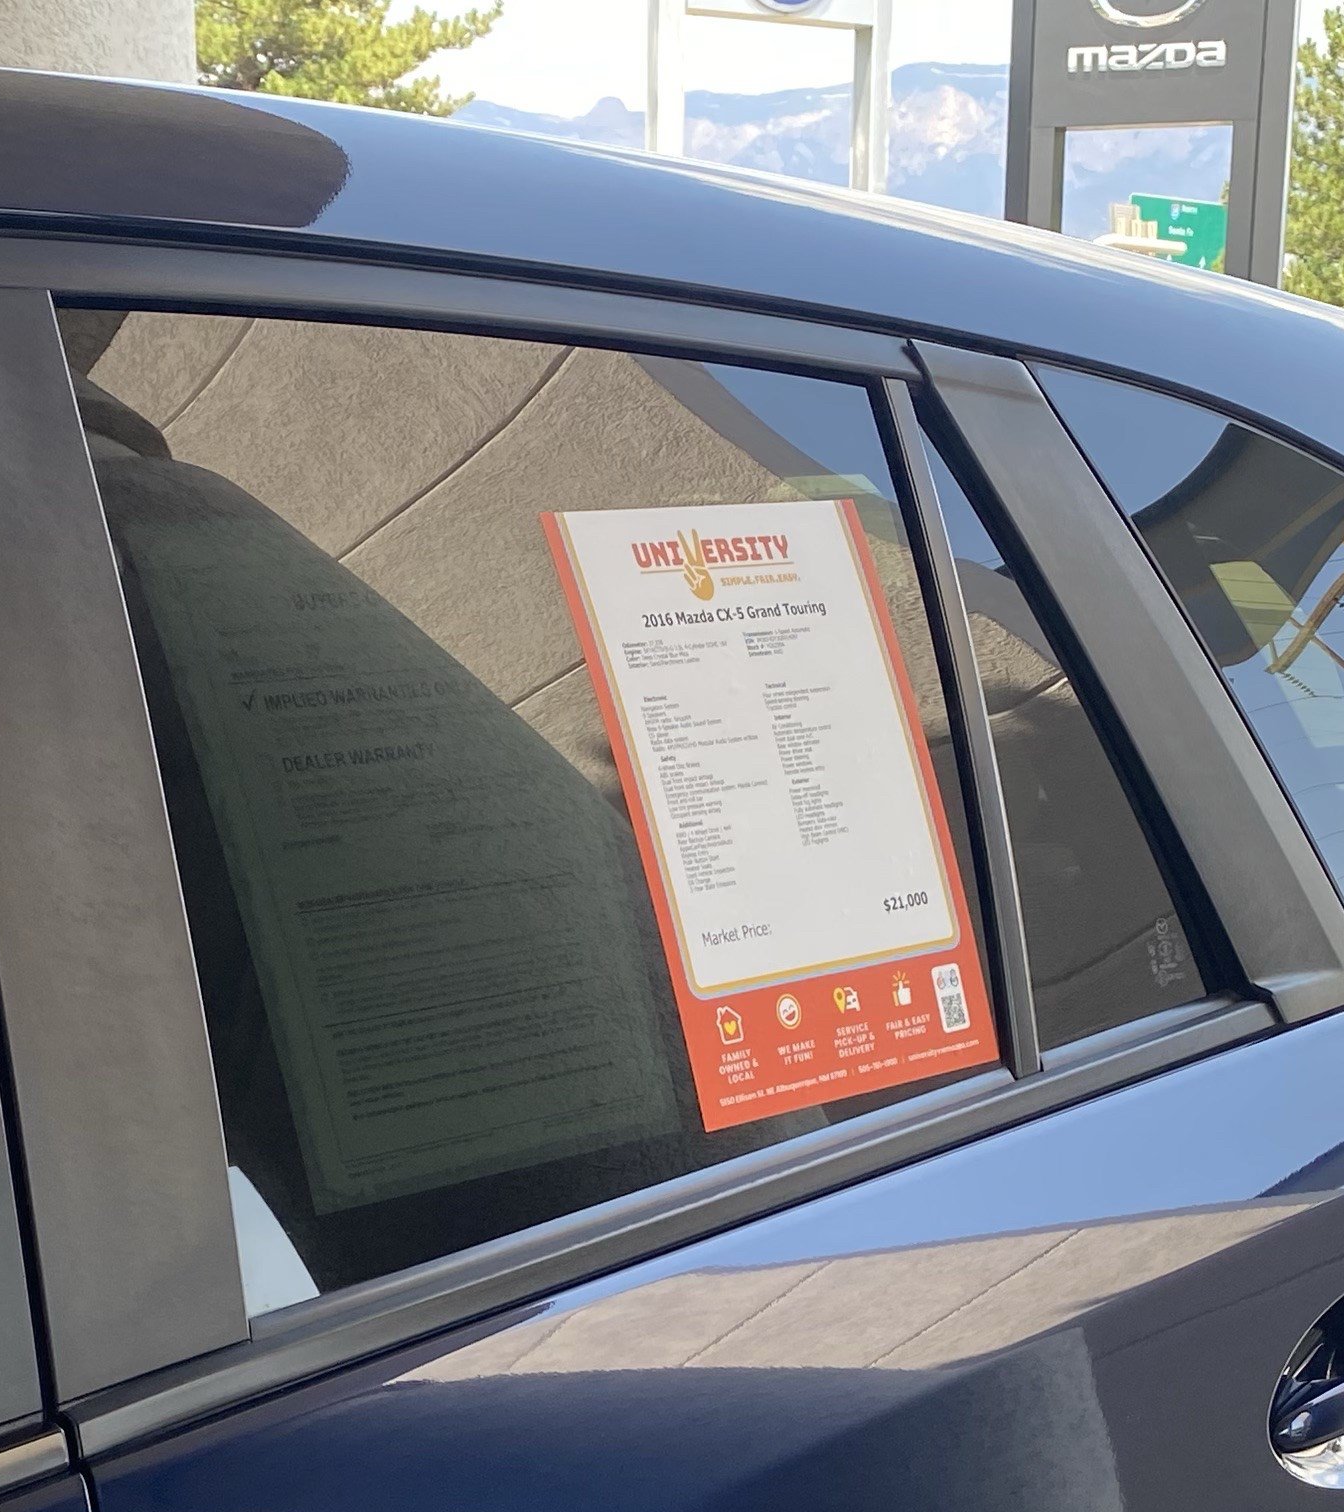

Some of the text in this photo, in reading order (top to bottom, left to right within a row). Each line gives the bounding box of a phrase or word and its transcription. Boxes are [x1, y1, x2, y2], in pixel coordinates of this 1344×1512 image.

[1067, 40, 1227, 73] mazda
[642, 600, 827, 628] 2016 Mazda CX-5 Grand Touring
[282, 741, 436, 773] DEALER WARRANTY
[883, 891, 929, 914] $21,000
[702, 922, 773, 948] Market Price:
[836, 1022, 869, 1037] SERVICE
[885, 1018, 904, 1031] FAIR
[911, 1013, 931, 1025] EASY
[834, 1033, 869, 1049] PICK-UP
[894, 1024, 927, 1040] PRICING
[721, 1048, 752, 1063] FAMILY
[777, 1039, 816, 1056] WE MAKE
[839, 1041, 875, 1059] DELIVERY
[719, 1057, 759, 1076] OWNED &
[784, 1050, 814, 1065] IT FUN!
[728, 1070, 755, 1084] LOCAL
